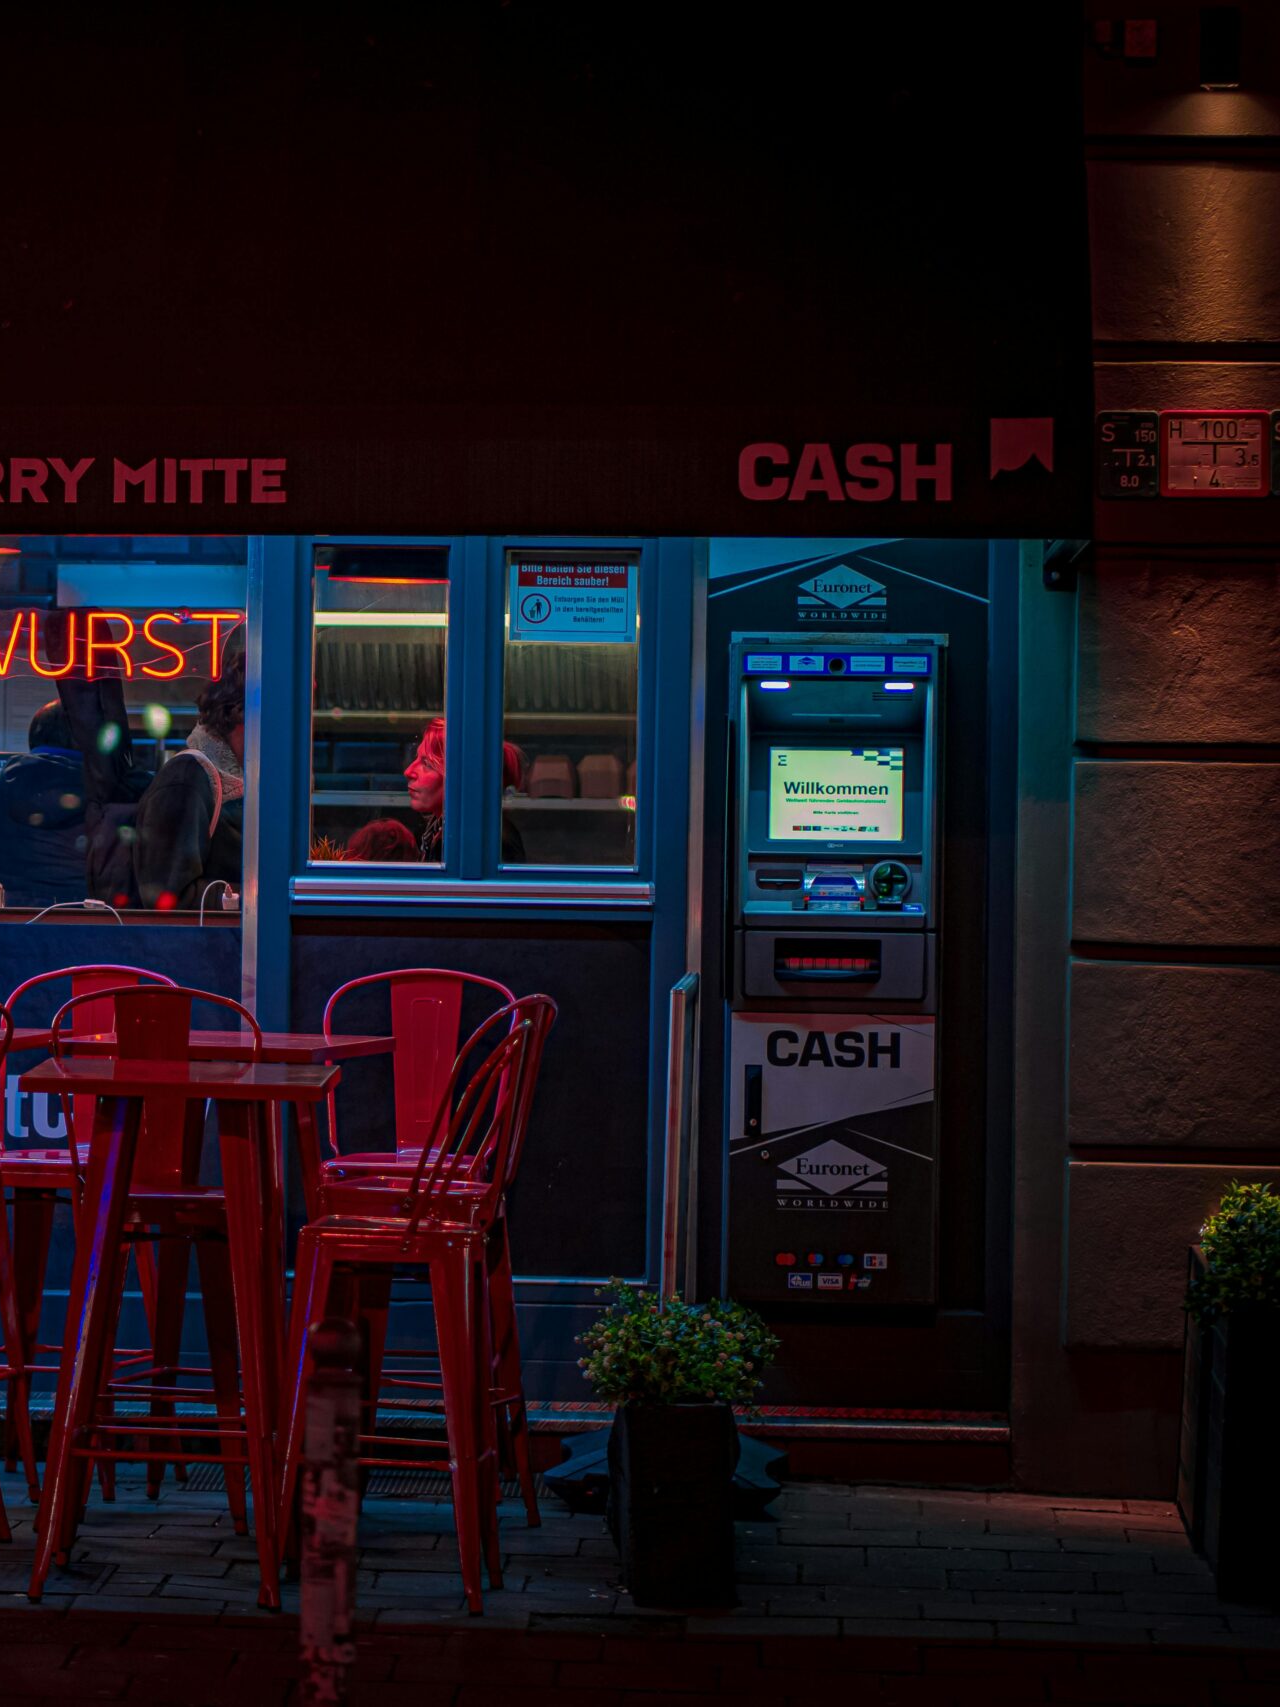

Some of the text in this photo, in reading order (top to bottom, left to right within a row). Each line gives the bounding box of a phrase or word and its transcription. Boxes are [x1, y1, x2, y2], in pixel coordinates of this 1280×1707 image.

[1101, 422, 1157, 443] S 150
[1170, 421, 1238, 439] H 100
[113, 457, 287, 504] MITTE
[738, 442, 953, 501] CASH
[537, 575, 609, 586] Bereich sauber!
[812, 579, 872, 594] Euronet
[784, 781, 889, 795] Willkommen
[767, 1030, 901, 1068] CASH
[795, 1158, 870, 1176] Euronet
[777, 1199, 889, 1209] WORLDWIDE
